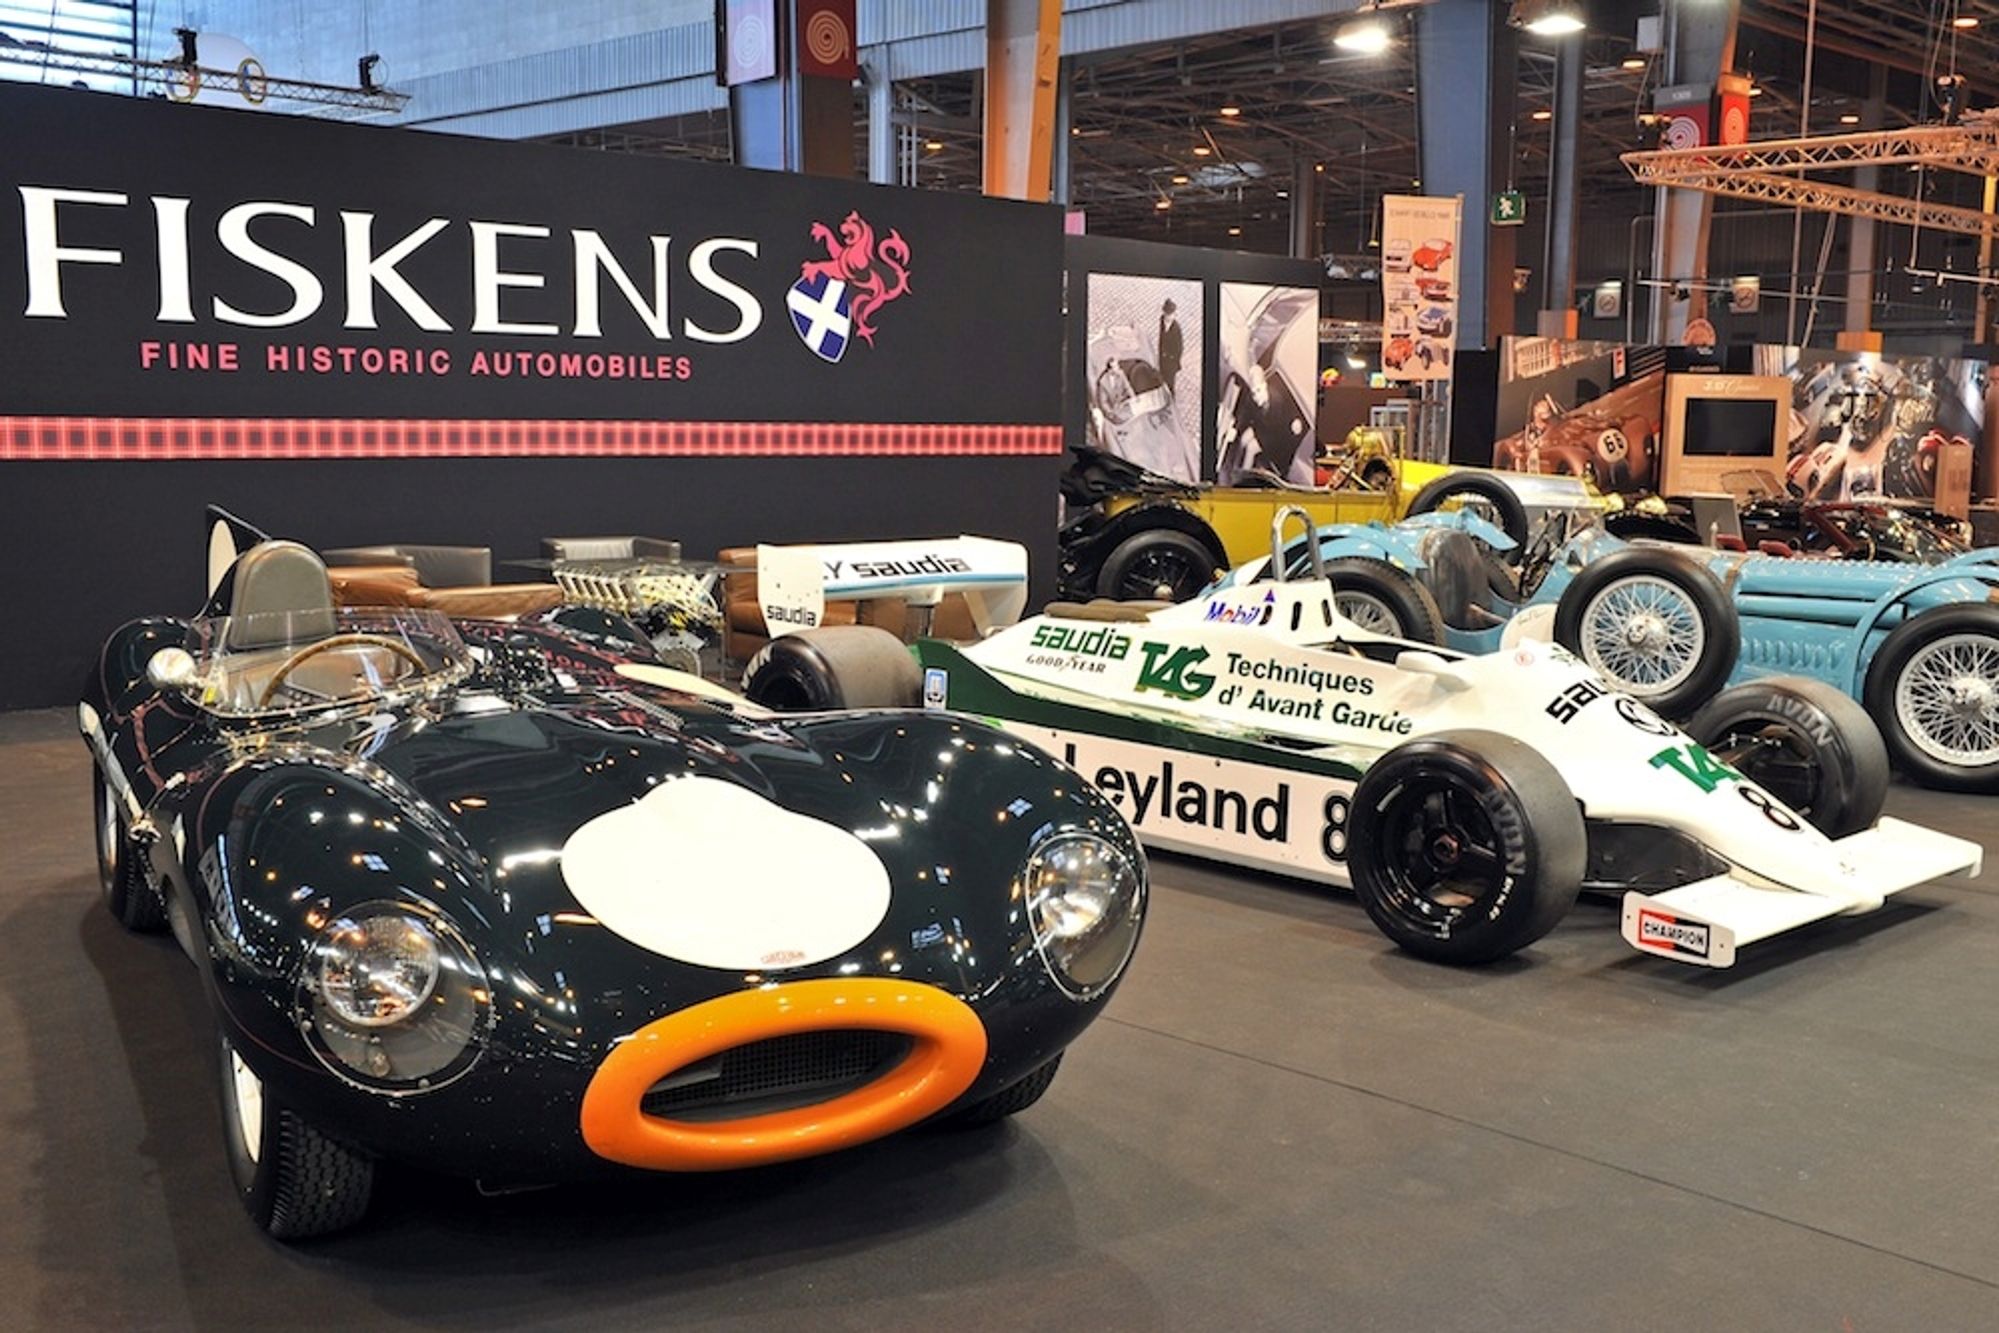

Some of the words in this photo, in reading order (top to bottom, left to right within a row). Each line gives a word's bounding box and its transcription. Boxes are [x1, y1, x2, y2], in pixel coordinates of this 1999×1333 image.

[18, 185, 763, 343] FISKENS
[141, 341, 240, 370] FINE
[267, 345, 451, 375] HISTORIC
[470, 351, 692, 380] AUTOMOBILES
[850, 553, 972, 579] saudia
[767, 605, 817, 627] saudia
[1203, 601, 1260, 625] Mobil
[1030, 624, 1131, 660] saudia
[1135, 641, 1216, 700] TAG
[1227, 652, 1374, 695] Techniques
[1249, 689, 1323, 721] Avant
[1766, 693, 1834, 747] AVON
[1738, 786, 1801, 831] 8
[1322, 794, 1350, 862] 8
[1643, 920, 1705, 946] CHAMPION
